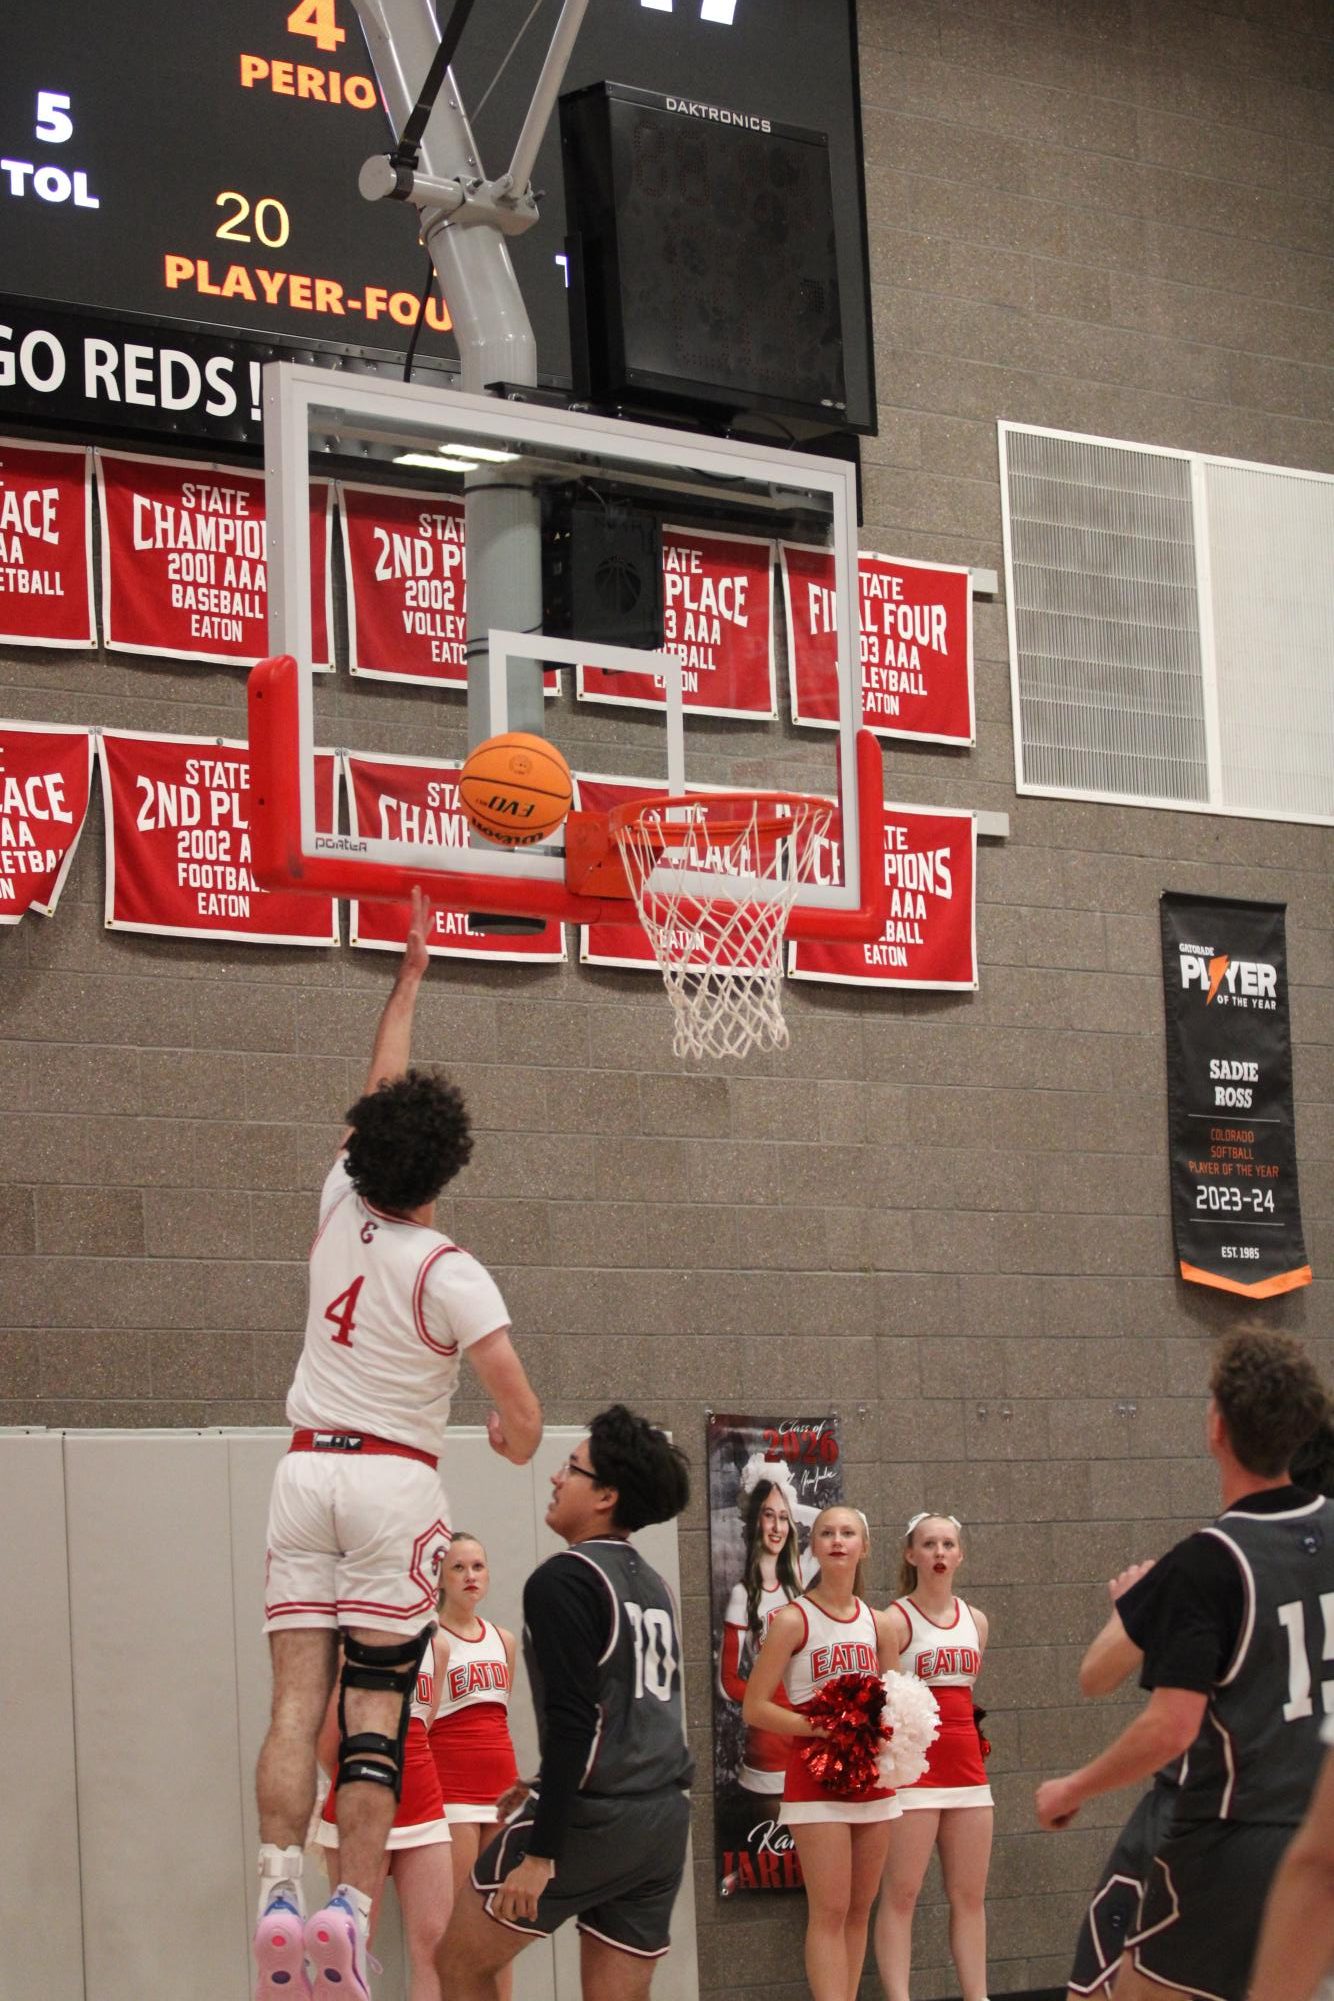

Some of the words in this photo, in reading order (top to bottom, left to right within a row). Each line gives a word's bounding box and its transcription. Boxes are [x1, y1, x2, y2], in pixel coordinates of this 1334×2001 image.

[287, 0, 345, 52] 4
[35, 92, 74, 143] 5
[665, 96, 772, 134] DAKTRONICS
[0, 159, 99, 209] TOL
[215, 191, 290, 249] 20
[181, 482, 250, 516] STATE
[373, 525, 434, 582] 2ND
[168, 552, 216, 585] 2001
[223, 556, 267, 593] AAA
[171, 583, 264, 619] BASEBALL
[405, 579, 455, 611] 2002
[664, 572, 748, 628] PLACE
[191, 614, 243, 643] EATON
[684, 611, 721, 646] AAA
[882, 604, 948, 656] FOUR
[884, 638, 921, 671] AAA
[185, 758, 250, 789] STATE
[0, 772, 73, 824] ACE
[136, 774, 201, 832] 2ND
[177, 829, 231, 862] 2002
[197, 892, 251, 918] EATON
[890, 888, 927, 920] AAA
[863, 943, 909, 967] EATON
[1178, 942, 1215, 957] GATORADE
[1216, 995, 1230, 1005] OF
[1232, 996, 1249, 1008] THE
[1252, 999, 1277, 1011] YEAR
[1209, 1059, 1260, 1083] SADIE
[1214, 1086, 1254, 1109] ROSS
[1210, 1128, 1256, 1144] COLORADO
[1210, 1145, 1255, 1160] SOFTBALL
[1188, 1160, 1220, 1176] PLAYER
[1222, 1163, 1234, 1176] OF
[1236, 1164, 1253, 1177] THE
[1256, 1165, 1280, 1179] YEAR
[1196, 1185, 1276, 1214] 2023-24
[1221, 1246, 1239, 1259] EST.
[1240, 1247, 1260, 1260] 1985
[323, 1274, 365, 1349] 4
[762, 1426, 840, 1466] 2026
